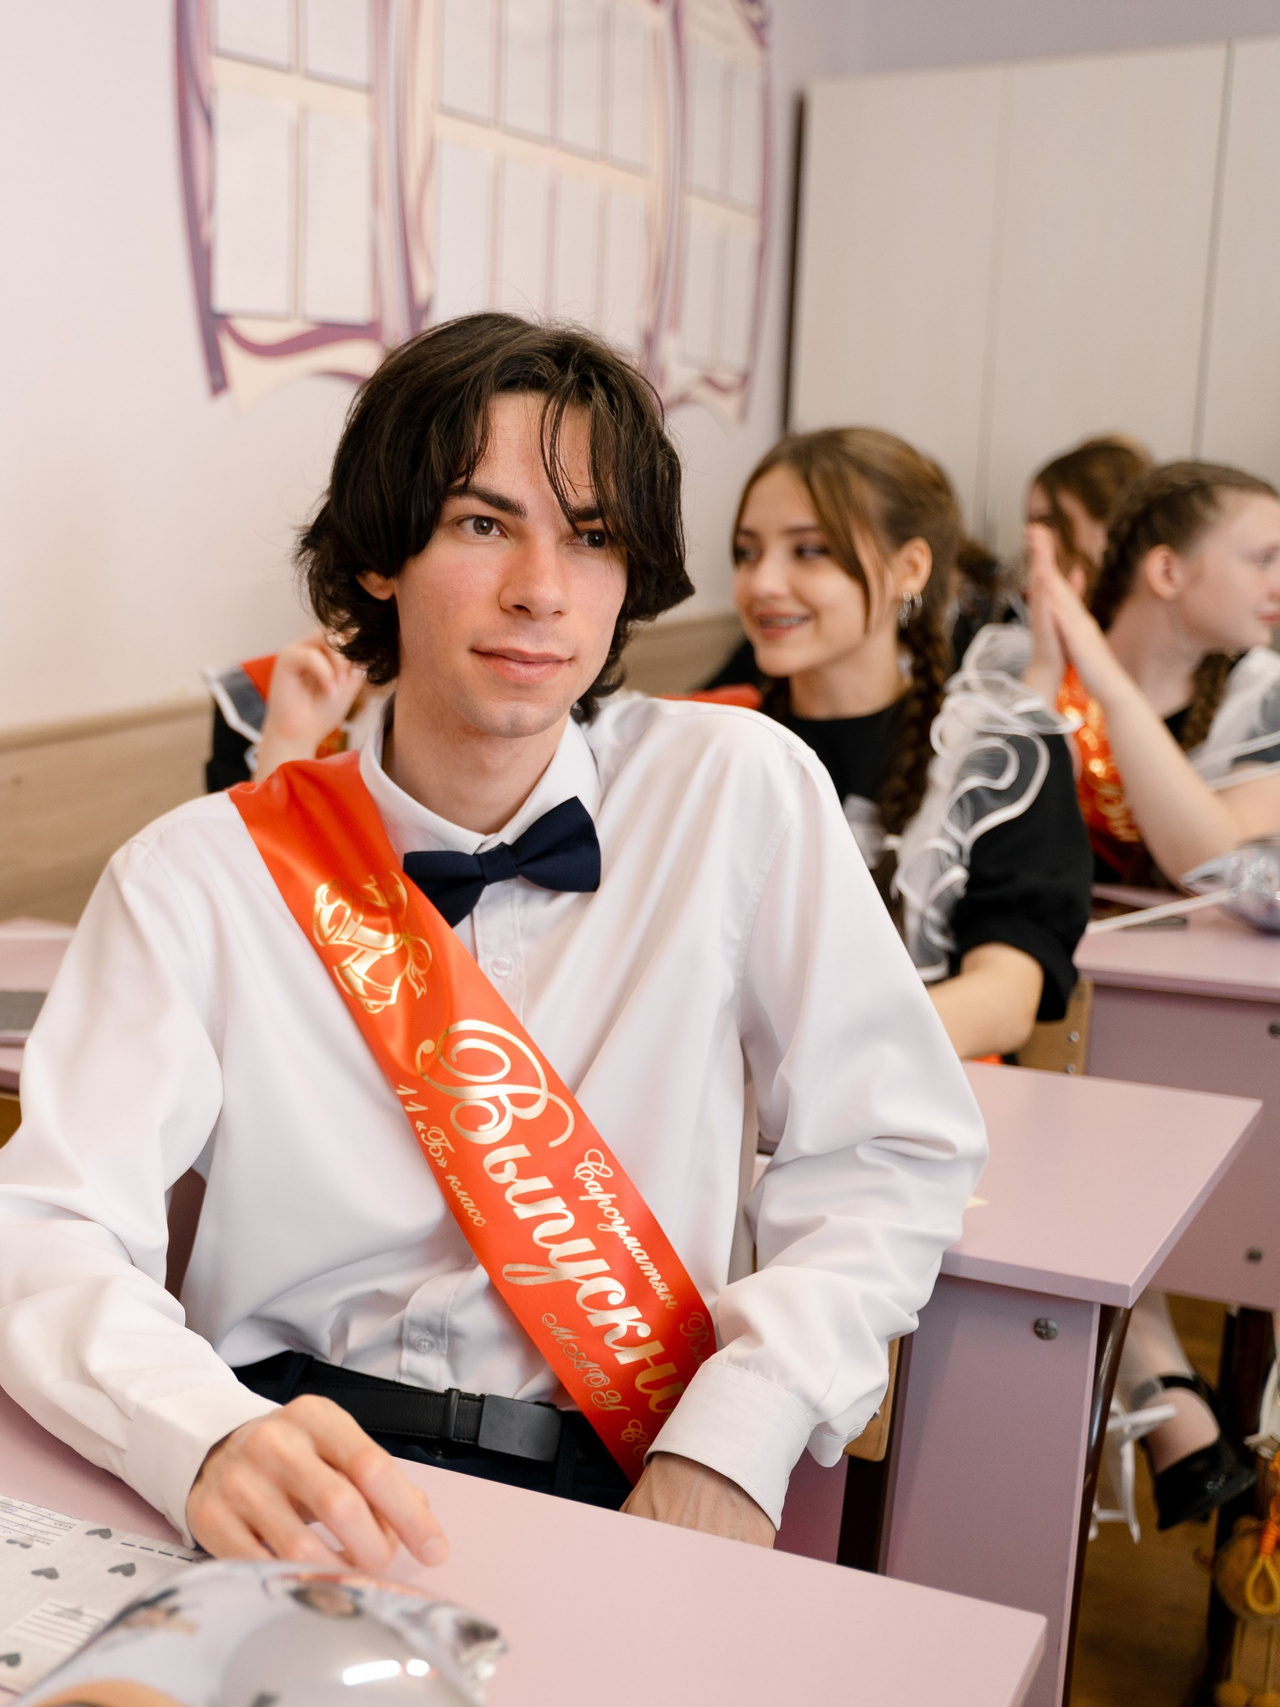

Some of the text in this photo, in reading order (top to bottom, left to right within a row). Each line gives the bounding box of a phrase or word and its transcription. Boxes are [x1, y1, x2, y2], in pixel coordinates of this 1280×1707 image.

[395, 1084, 429, 1113] 11
[445, 1174, 487, 1228] класс
[415, 1019, 686, 1422] Выпускни
[541, 1312, 631, 1412] МАОУ
